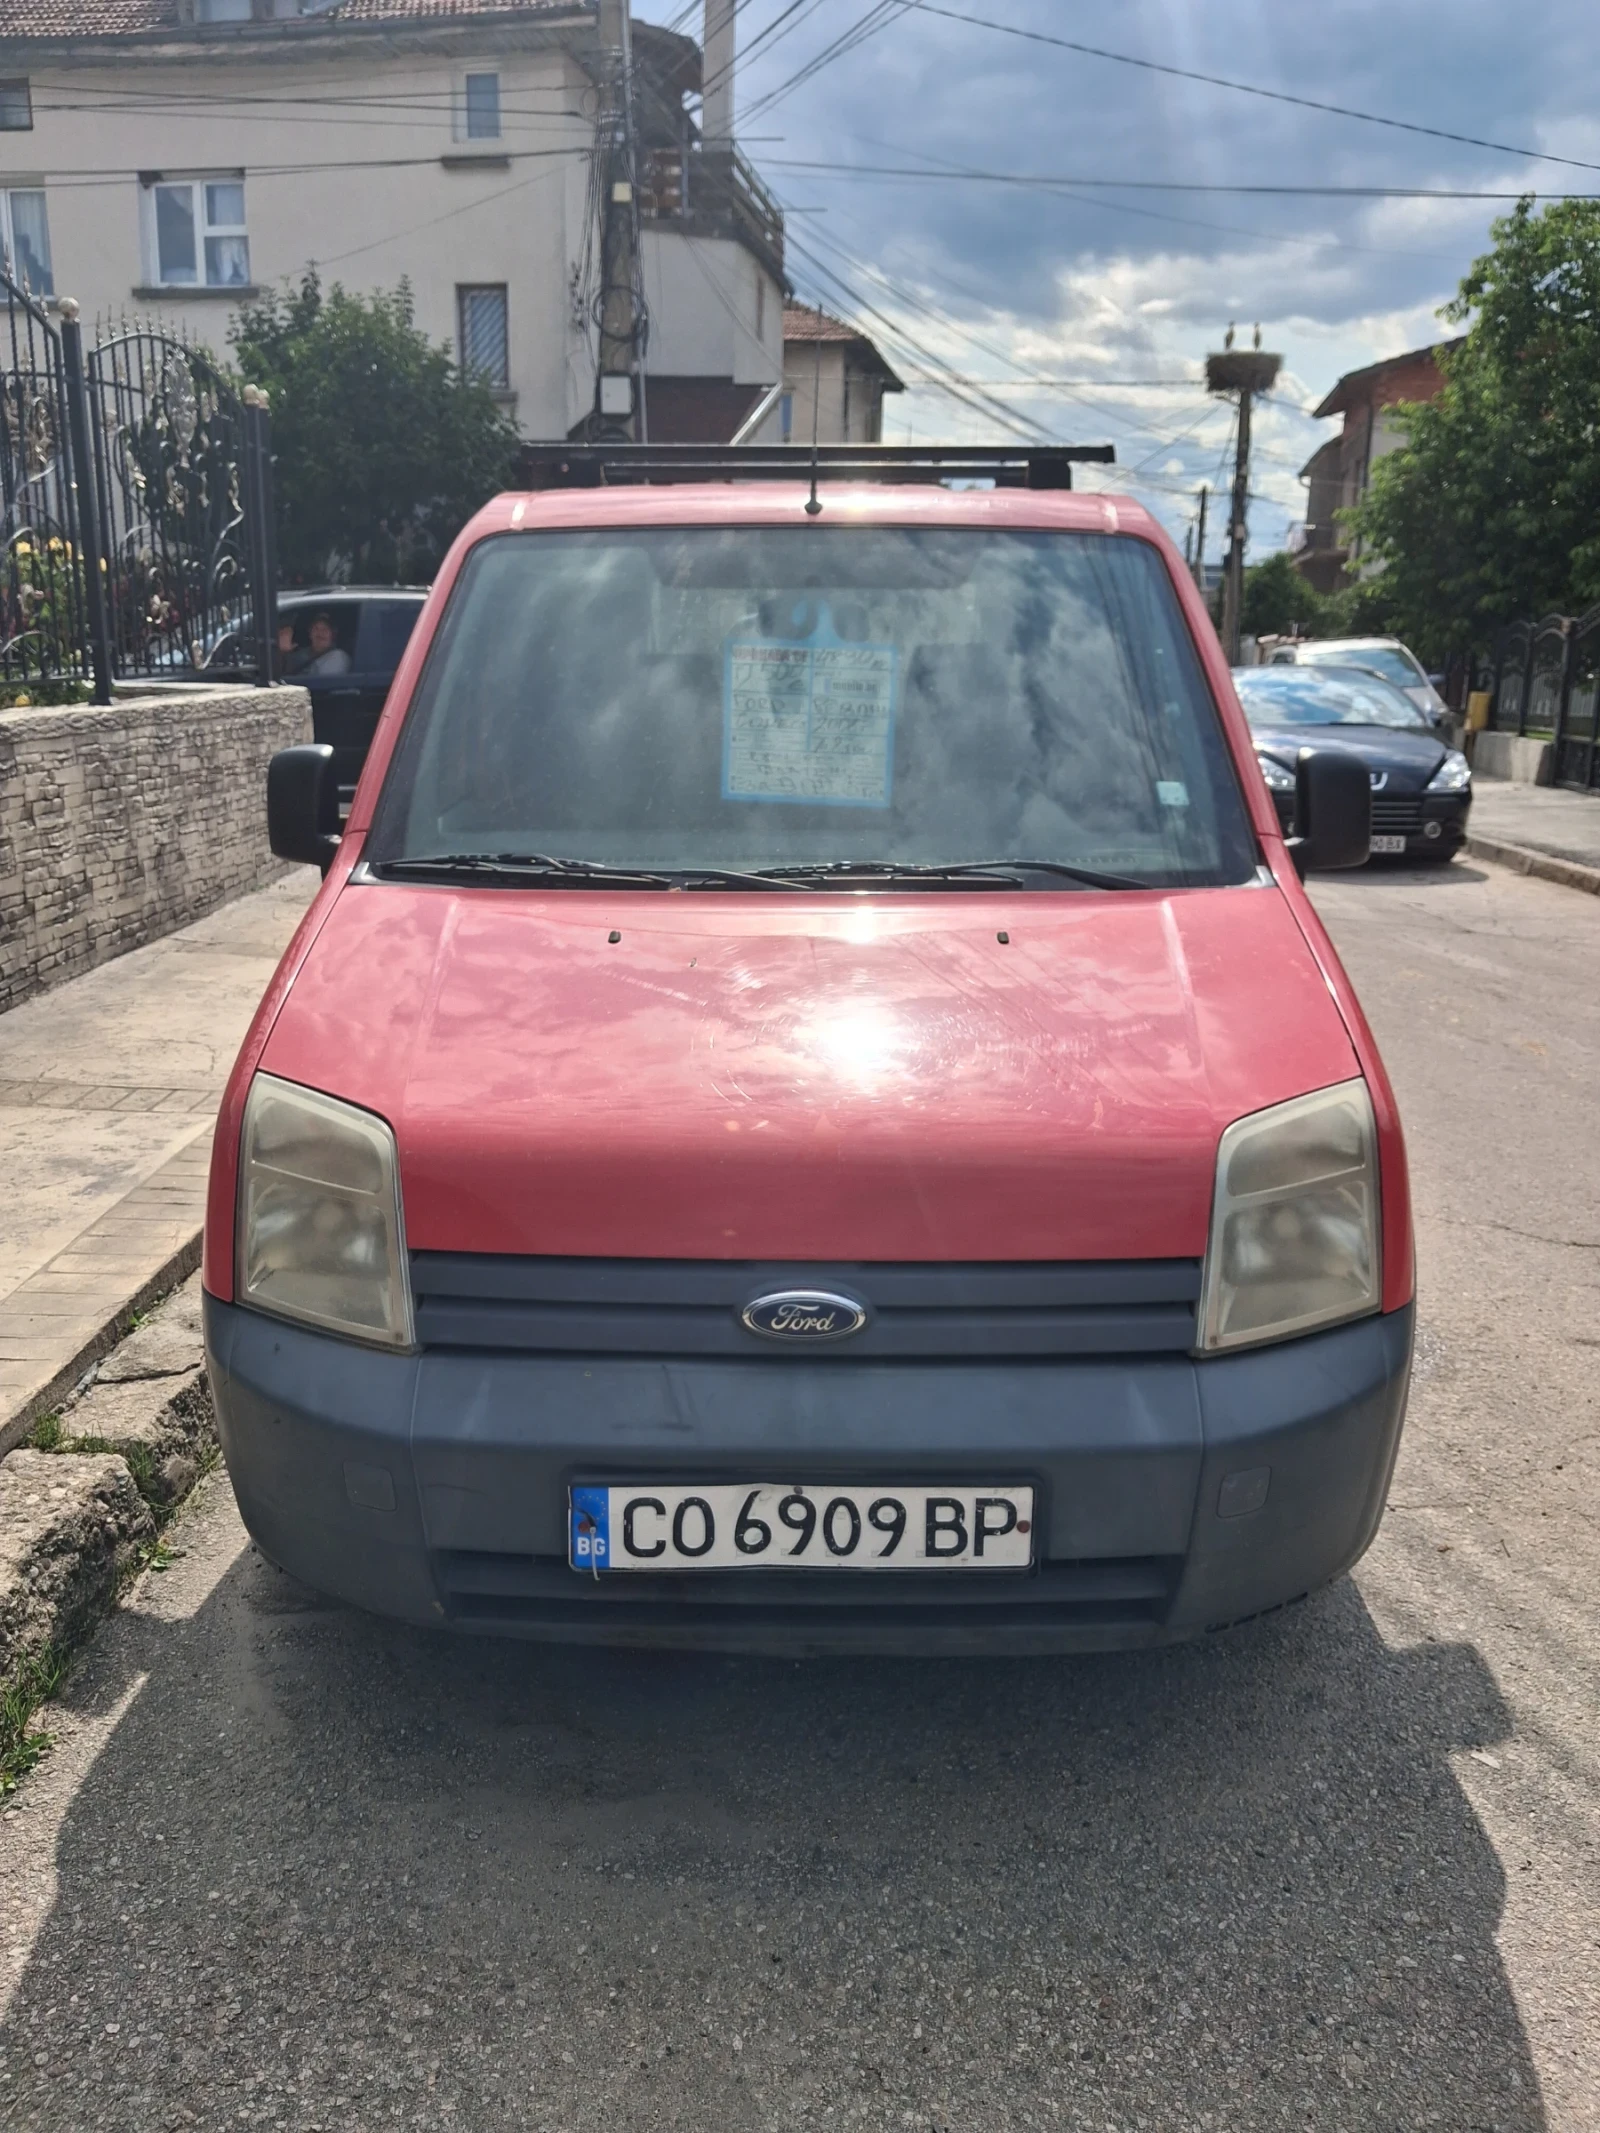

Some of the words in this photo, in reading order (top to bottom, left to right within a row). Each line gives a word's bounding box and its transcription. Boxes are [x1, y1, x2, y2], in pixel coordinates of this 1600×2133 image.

[771, 1304, 835, 1332] Ford
[623, 1496, 715, 1557] CO
[733, 1490, 907, 1557] 6909
[924, 1497, 1018, 1557] BP
[576, 1536, 606, 1556] BG
